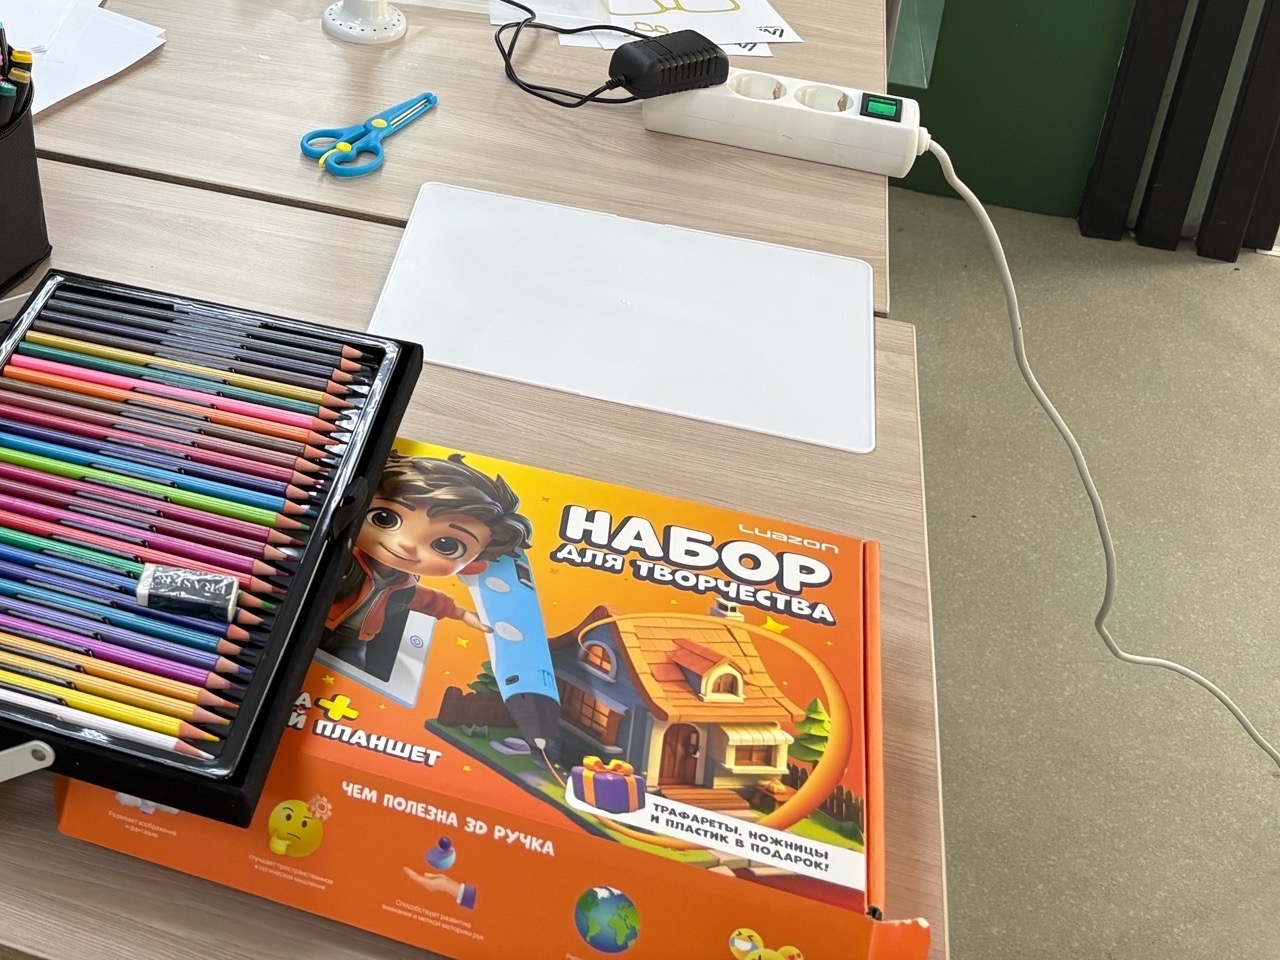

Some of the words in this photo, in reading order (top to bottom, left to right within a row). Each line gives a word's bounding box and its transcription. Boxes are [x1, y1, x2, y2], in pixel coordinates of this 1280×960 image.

[562, 504, 832, 594] НАБОР
[556, 543, 624, 571] ДЛЯ
[634, 559, 837, 624] ТВОРЧЕСТВА
[315, 719, 443, 767] ПЛАНШЕТ
[342, 780, 377, 804] ЧЕМ
[383, 792, 458, 828] ПОЛЕЗНА
[464, 816, 488, 836] 3D
[493, 824, 555, 857] РУЧКА
[650, 813, 660, 824] И
[665, 818, 729, 845] ПЛАСТИК
[735, 838, 745, 848] В
[750, 842, 830, 872] ПОДАРОК!
[748, 829, 830, 861] НОЖНИЦЫ
[395, 899, 440, 920] Способствует
[472, 932, 485, 942] рук
